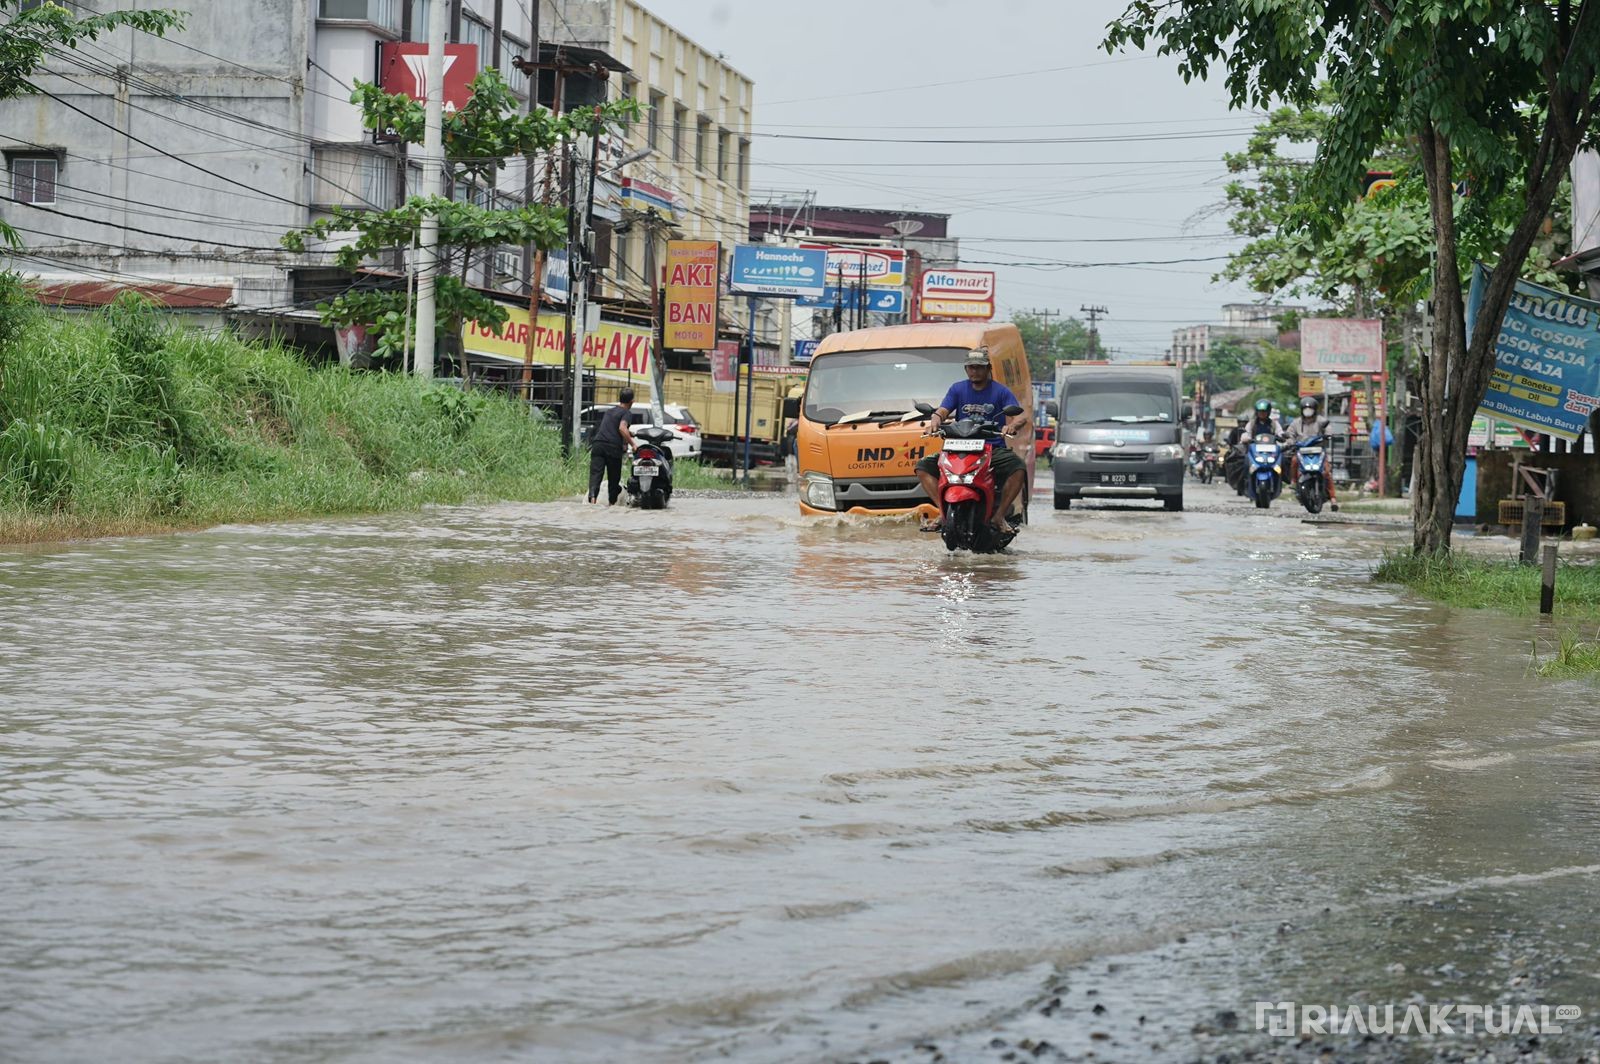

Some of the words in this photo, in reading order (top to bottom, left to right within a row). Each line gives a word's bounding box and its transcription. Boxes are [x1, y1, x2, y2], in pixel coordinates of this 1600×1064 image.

[756, 251, 804, 262] Hannochs
[670, 264, 713, 286] AKI
[926, 274, 989, 289] Alfamart
[669, 303, 711, 323] BAN
[674, 331, 703, 341] MOTOR
[1501, 315, 1527, 334] UCI
[1530, 327, 1588, 349] GOSOK
[606, 332, 649, 374] AKI
[1543, 347, 1586, 367] SAJA
[1521, 358, 1563, 378] SAJA
[1521, 377, 1553, 392] Boneka
[1528, 391, 1540, 401] Dil
[1496, 401, 1525, 416] Bhakti
[1526, 411, 1553, 424] Labuh
[1554, 418, 1575, 431] Baru
